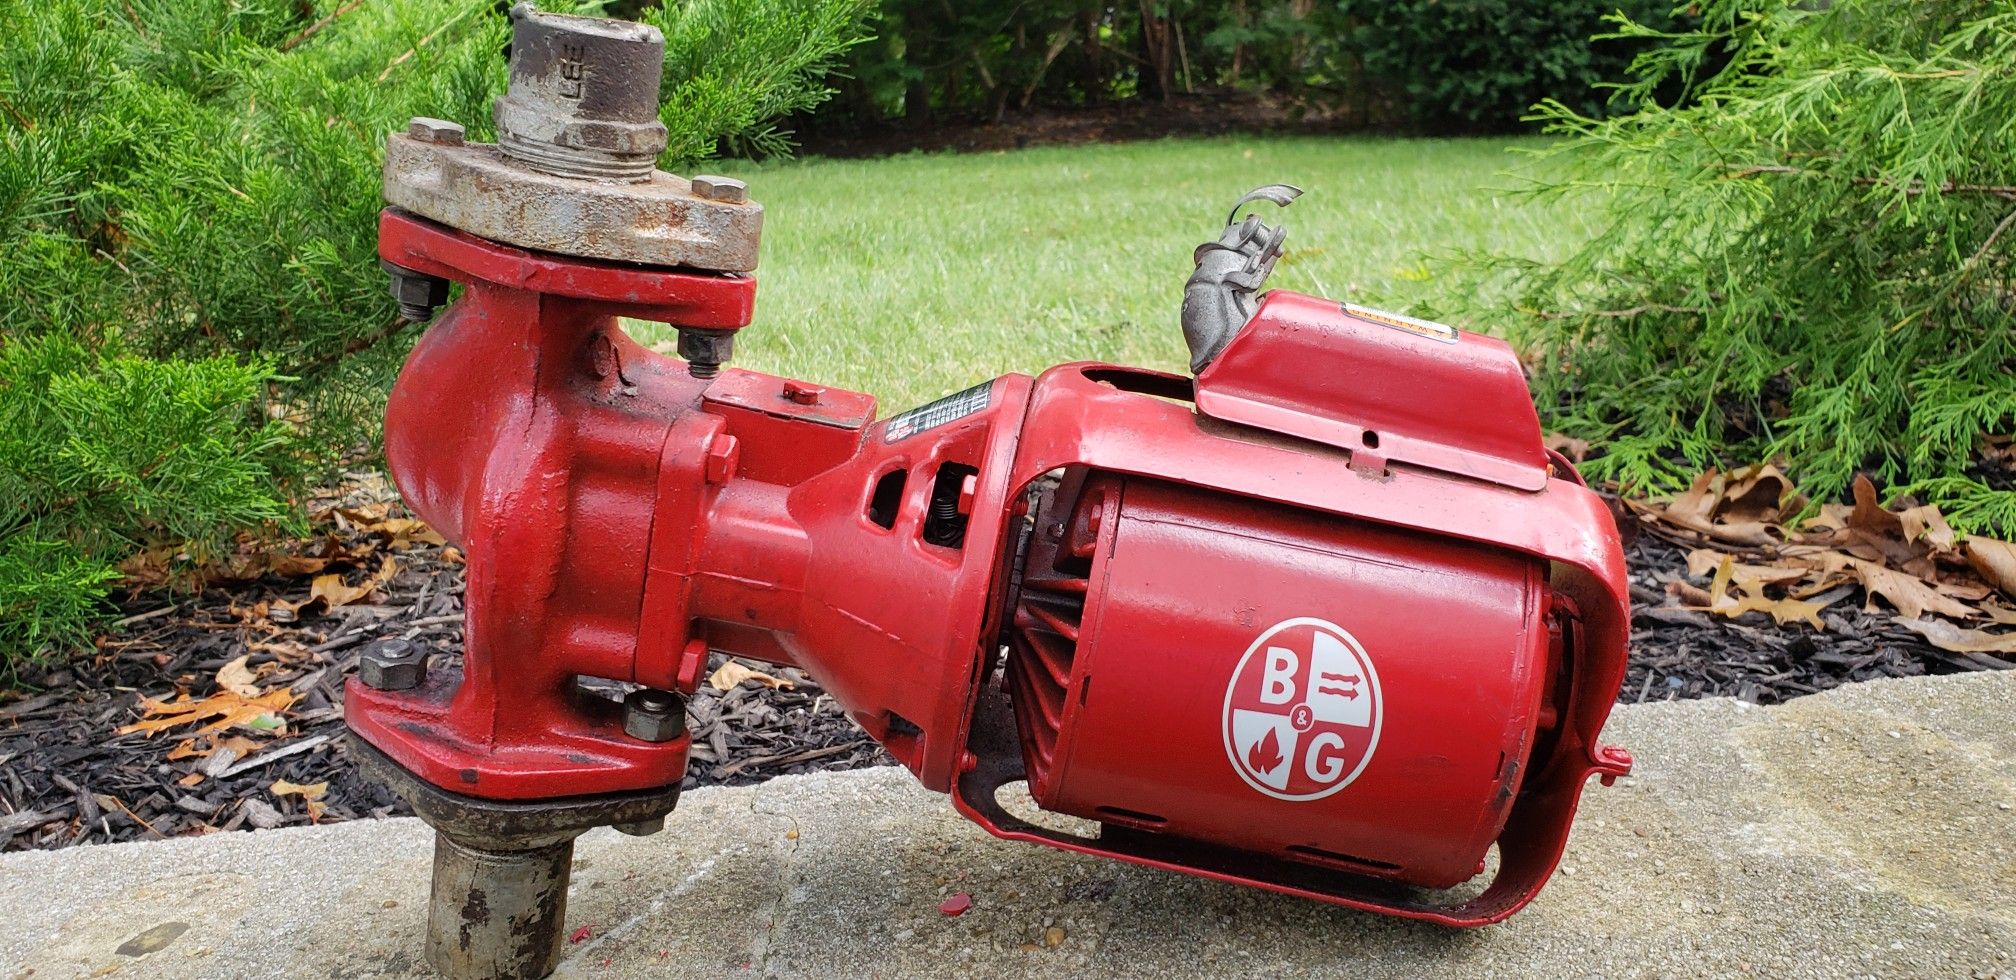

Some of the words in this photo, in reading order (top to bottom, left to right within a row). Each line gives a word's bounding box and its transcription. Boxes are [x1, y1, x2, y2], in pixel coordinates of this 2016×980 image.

[1352, 309, 1428, 333] WARNING
[1260, 646, 1299, 705] B
[1296, 709, 1307, 726] &
[1304, 731, 1345, 784] G
